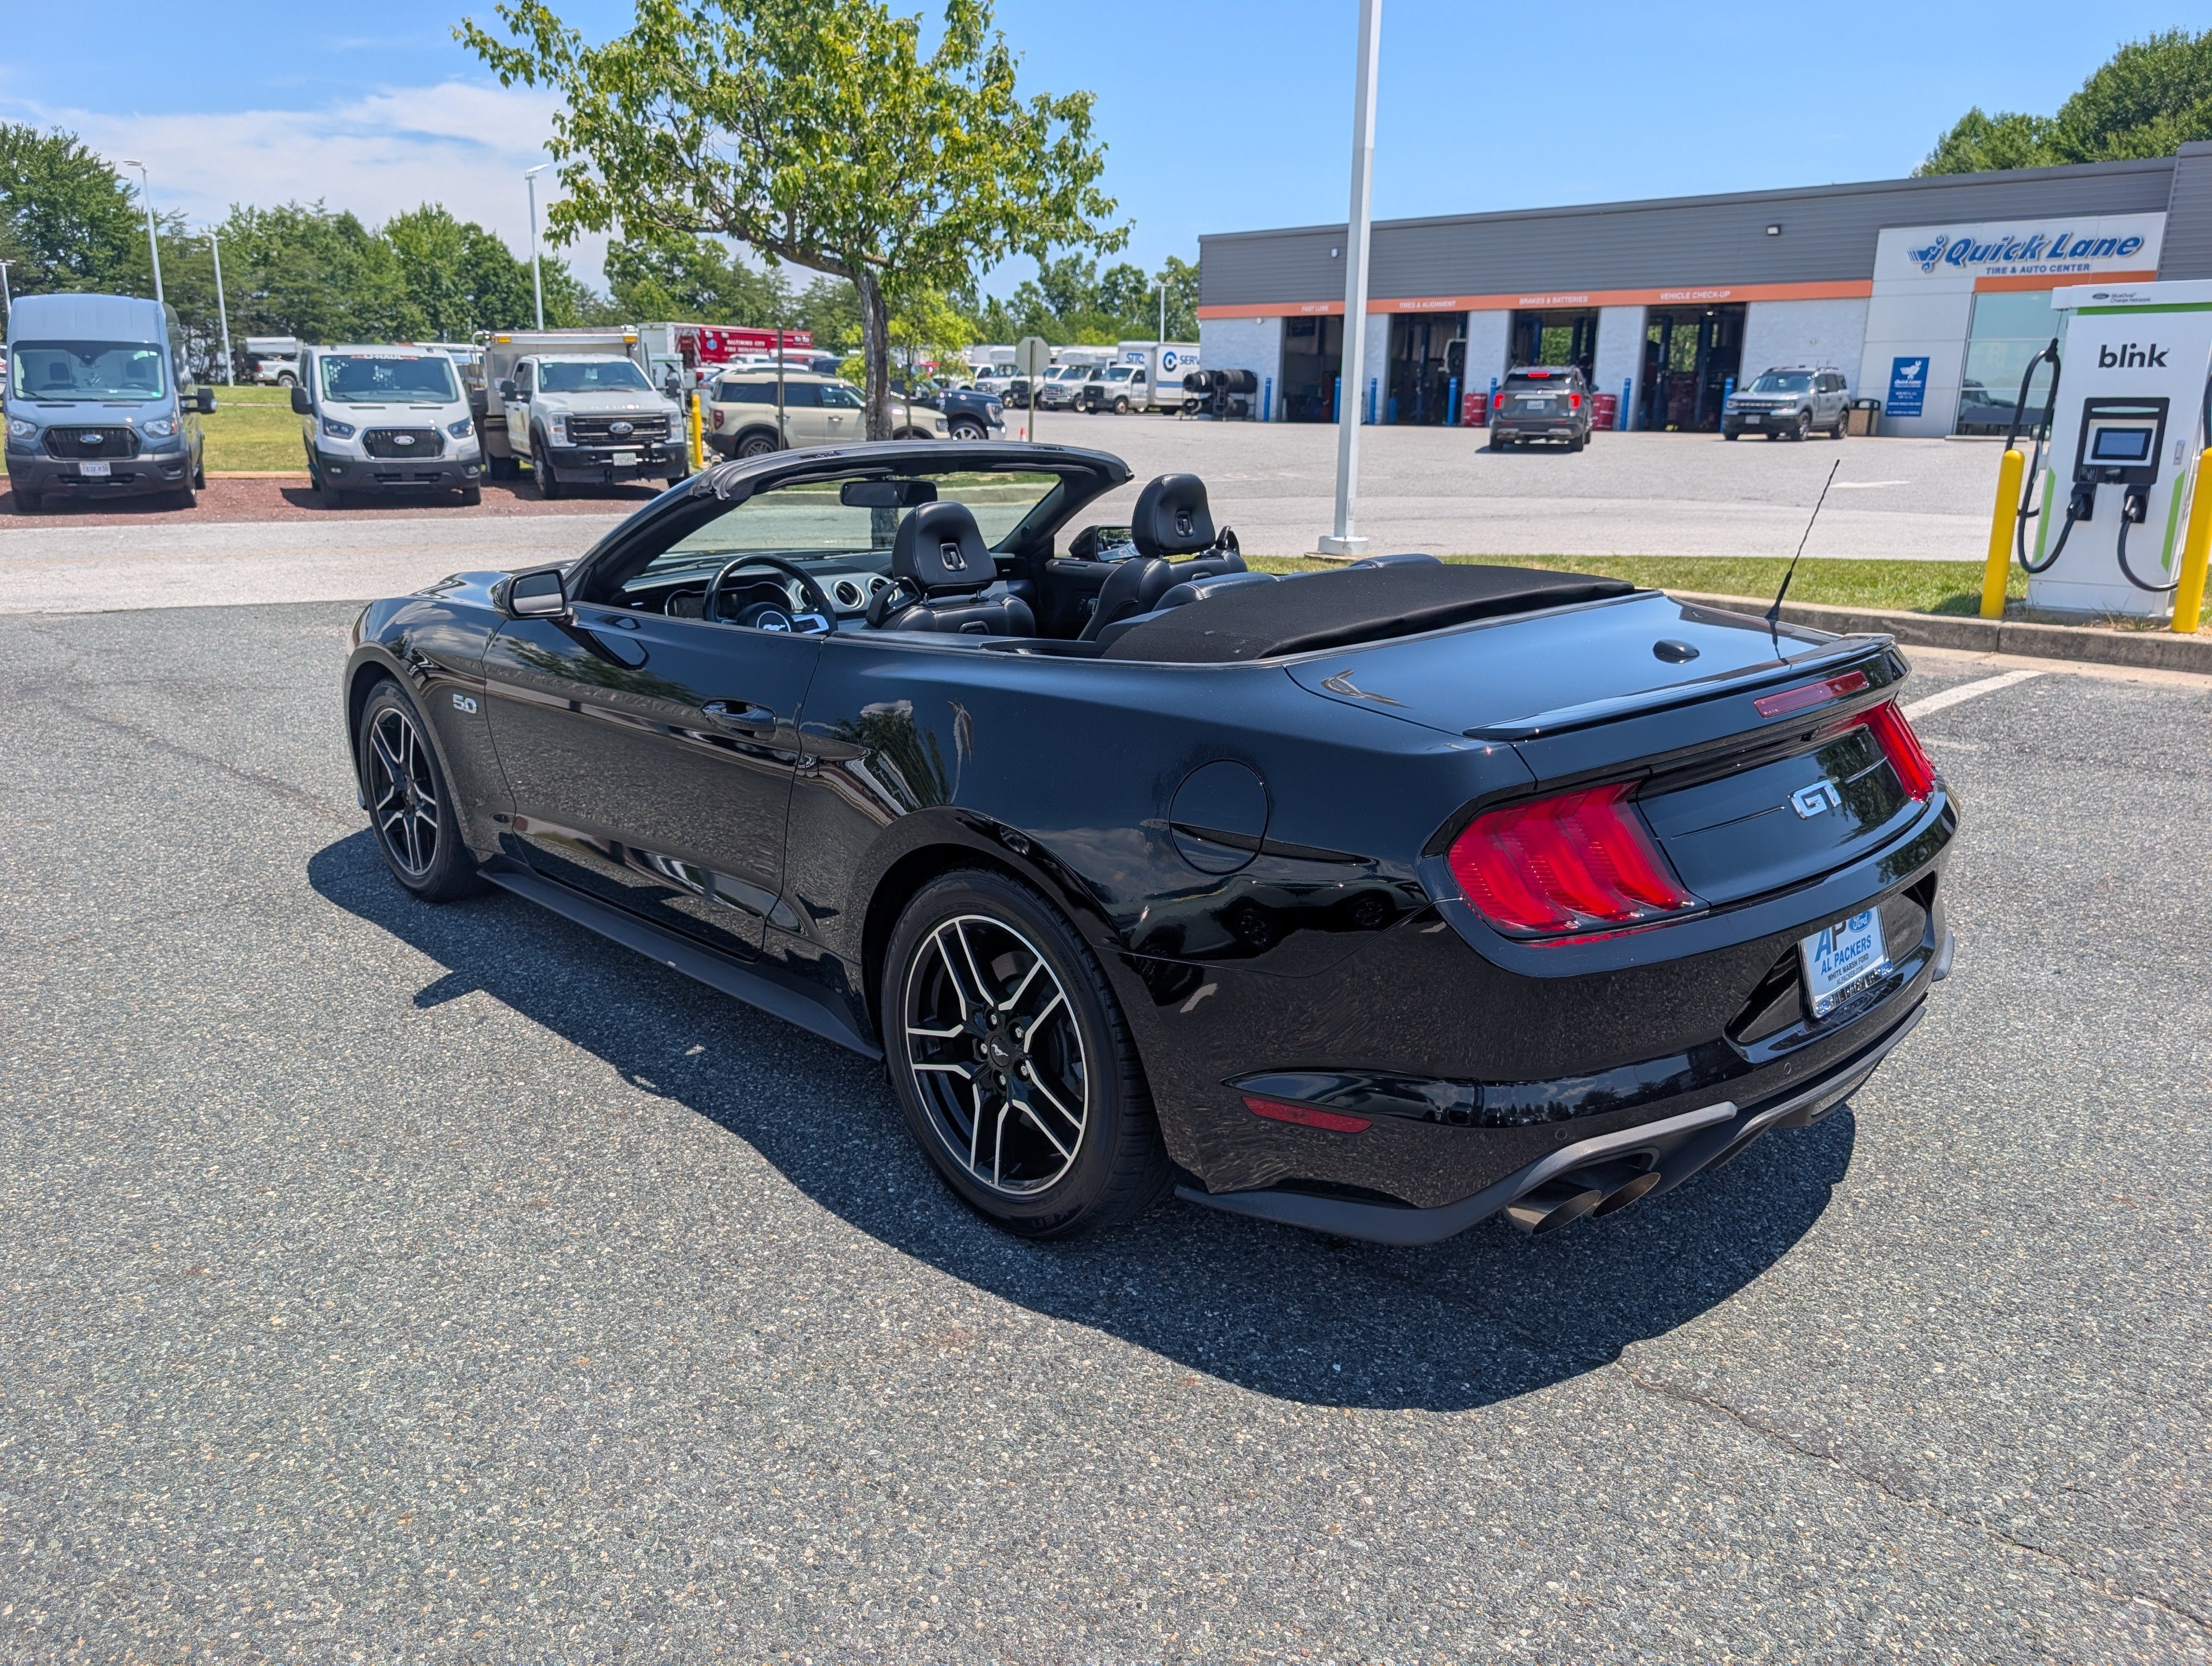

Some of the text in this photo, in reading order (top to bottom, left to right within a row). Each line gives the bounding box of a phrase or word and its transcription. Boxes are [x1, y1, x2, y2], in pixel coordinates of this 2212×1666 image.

[1944, 232, 2144, 267] Quick Lane
[2016, 265, 2046, 273] AUTO
[2048, 264, 2090, 273] CENTER
[1552, 295, 1589, 304] BATTERIES
[1660, 291, 1690, 300] VEHICLE
[2098, 343, 2168, 368] blink
[1788, 777, 1842, 819] GT
[1852, 912, 1868, 930] Ford
[1815, 921, 1847, 963] AP
[1821, 934, 1872, 976] AL PACKERS
[1827, 952, 1869, 982] WHITE MARSH FORD
